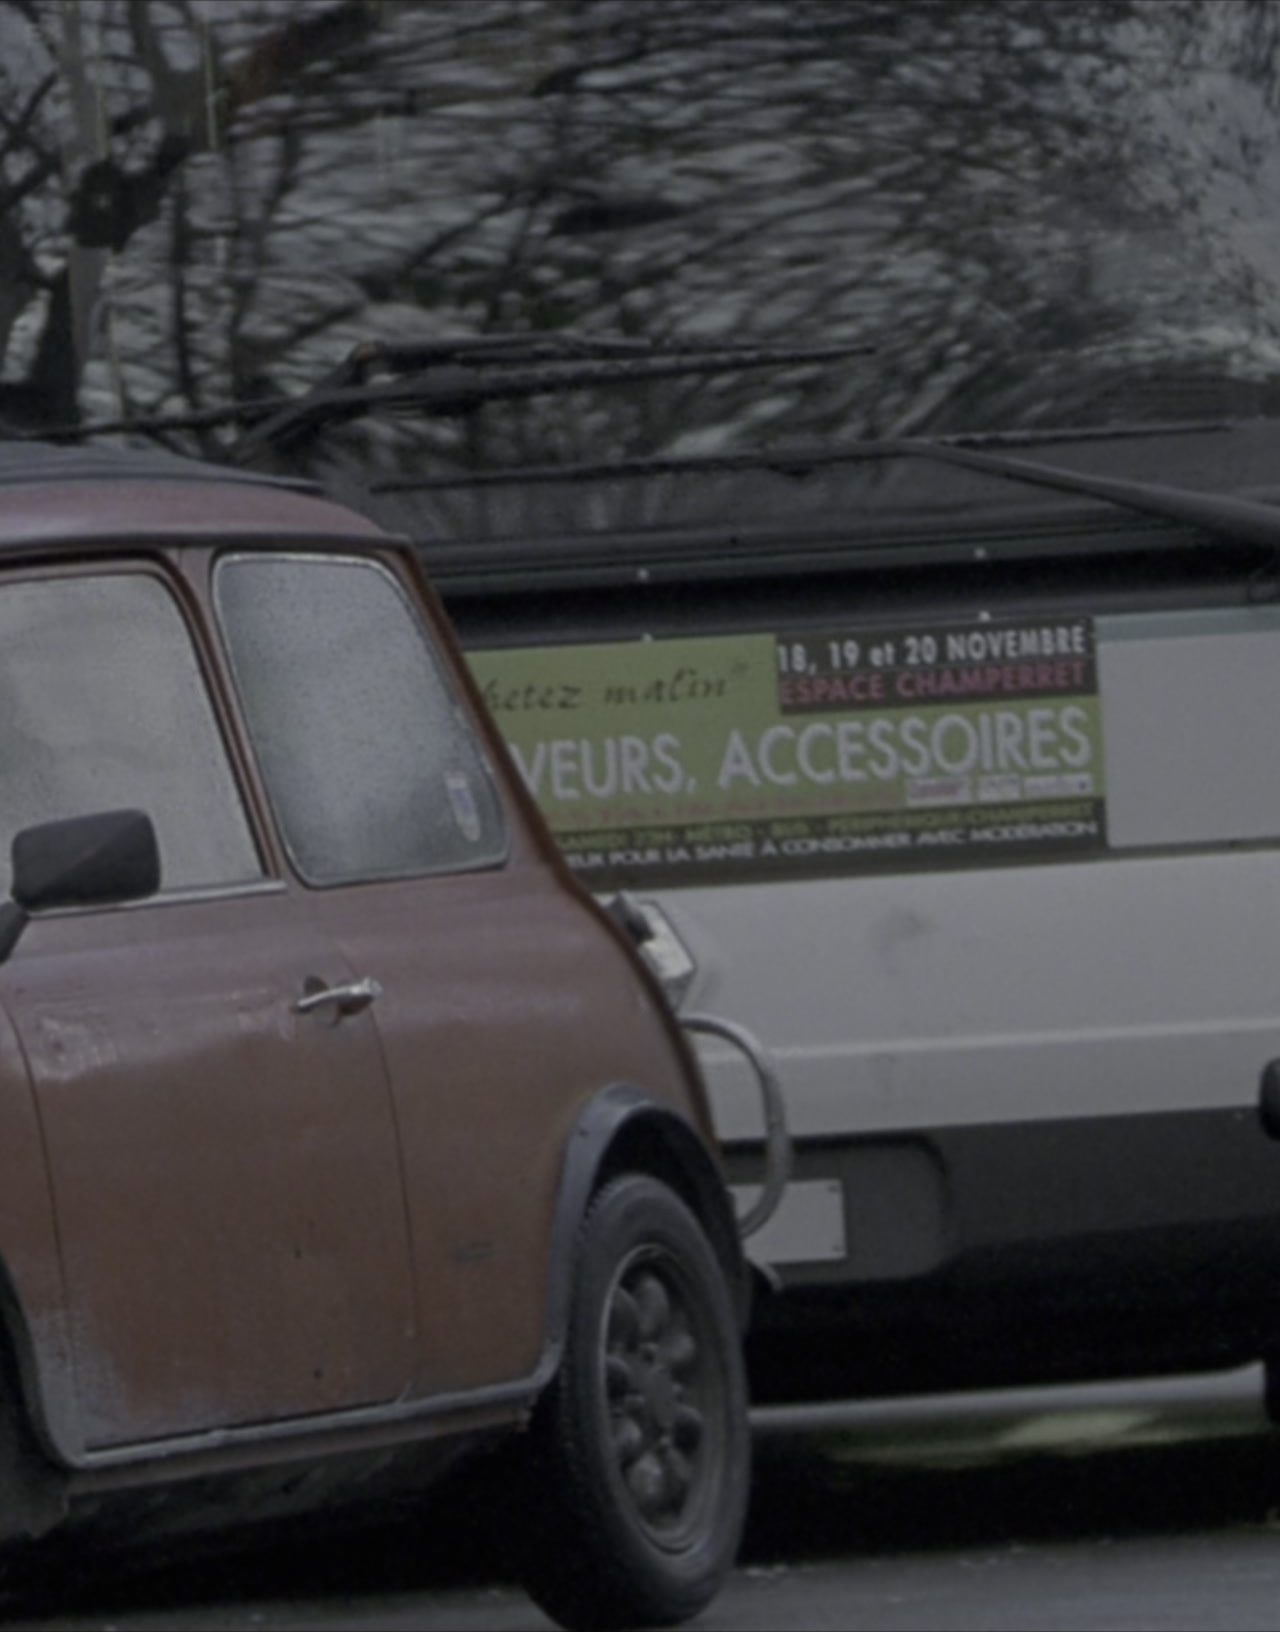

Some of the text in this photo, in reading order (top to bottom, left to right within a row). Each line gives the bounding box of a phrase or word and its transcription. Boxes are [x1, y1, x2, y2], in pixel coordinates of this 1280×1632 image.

[776, 625, 1086, 675] 18, 19 et 20 NOVEMBRE
[780, 661, 1087, 704] ESPACE CHAMPERRET
[509, 707, 1091, 798] VEURS, ACCESSOIRES
